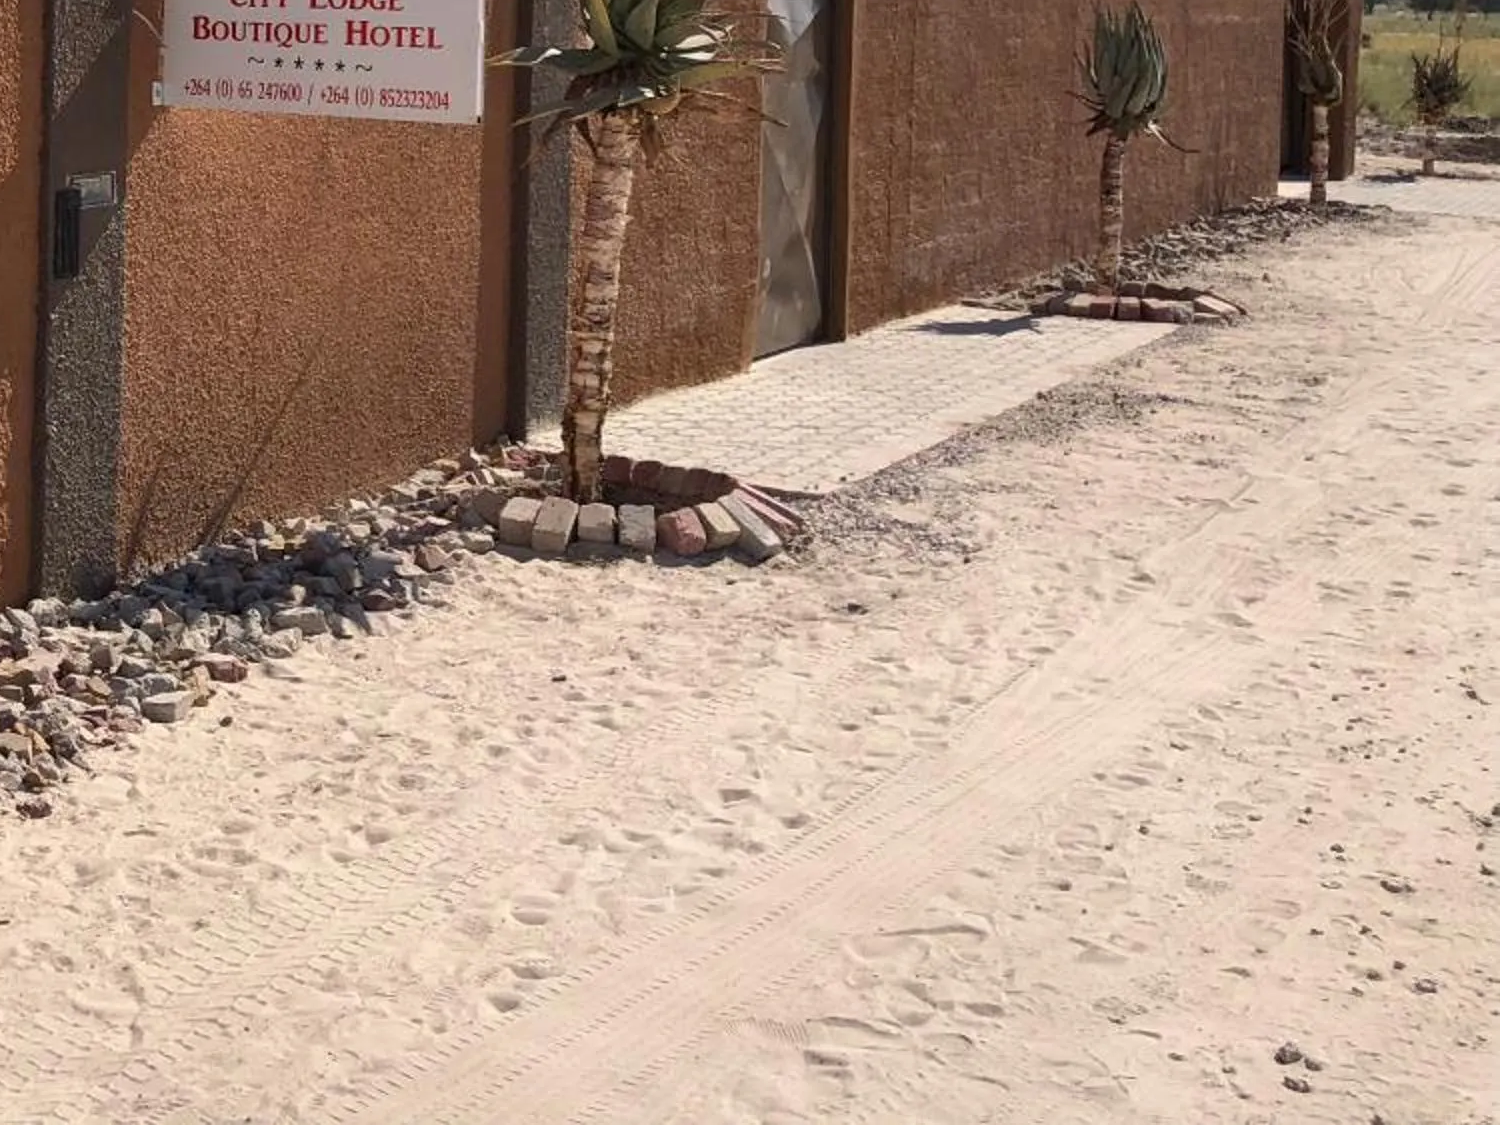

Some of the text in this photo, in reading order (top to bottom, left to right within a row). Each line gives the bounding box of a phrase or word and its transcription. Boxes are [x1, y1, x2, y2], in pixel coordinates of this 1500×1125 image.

[192, 15, 443, 49] BOUTIQUE HOTEL
[185, 78, 211, 96] +264
[216, 78, 233, 100] (0)
[238, 80, 253, 98] 65
[258, 82, 302, 102] 247600
[321, 85, 349, 105] +264
[355, 86, 375, 109] (0)
